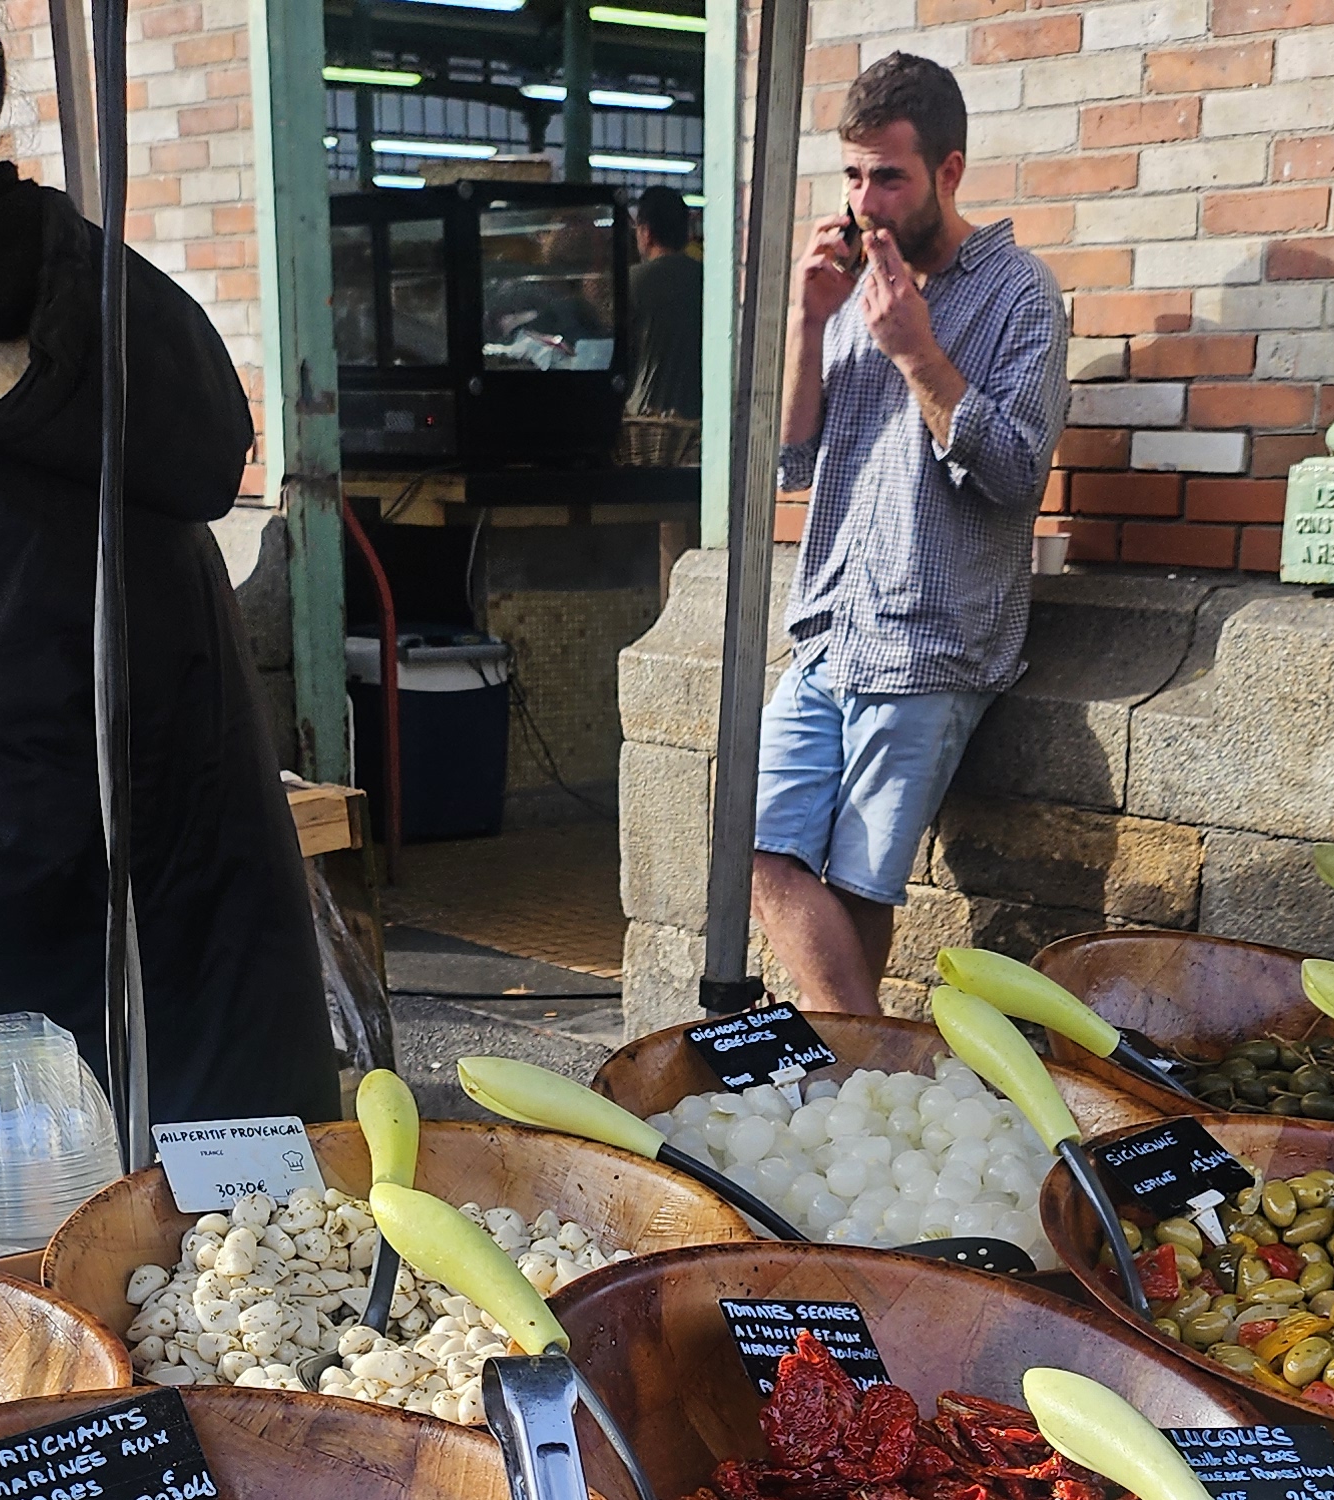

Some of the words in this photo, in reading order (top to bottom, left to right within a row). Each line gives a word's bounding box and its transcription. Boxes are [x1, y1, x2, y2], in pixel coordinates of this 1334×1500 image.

[159, 1128, 227, 1144] AILPERITIF
[231, 1124, 303, 1139] PROVENCAL
[813, 1328, 830, 1342] ET
[835, 1331, 862, 1343] AUX
[120, 1429, 170, 1457] AUX
[1170, 1425, 1294, 1448] LUCQUES
